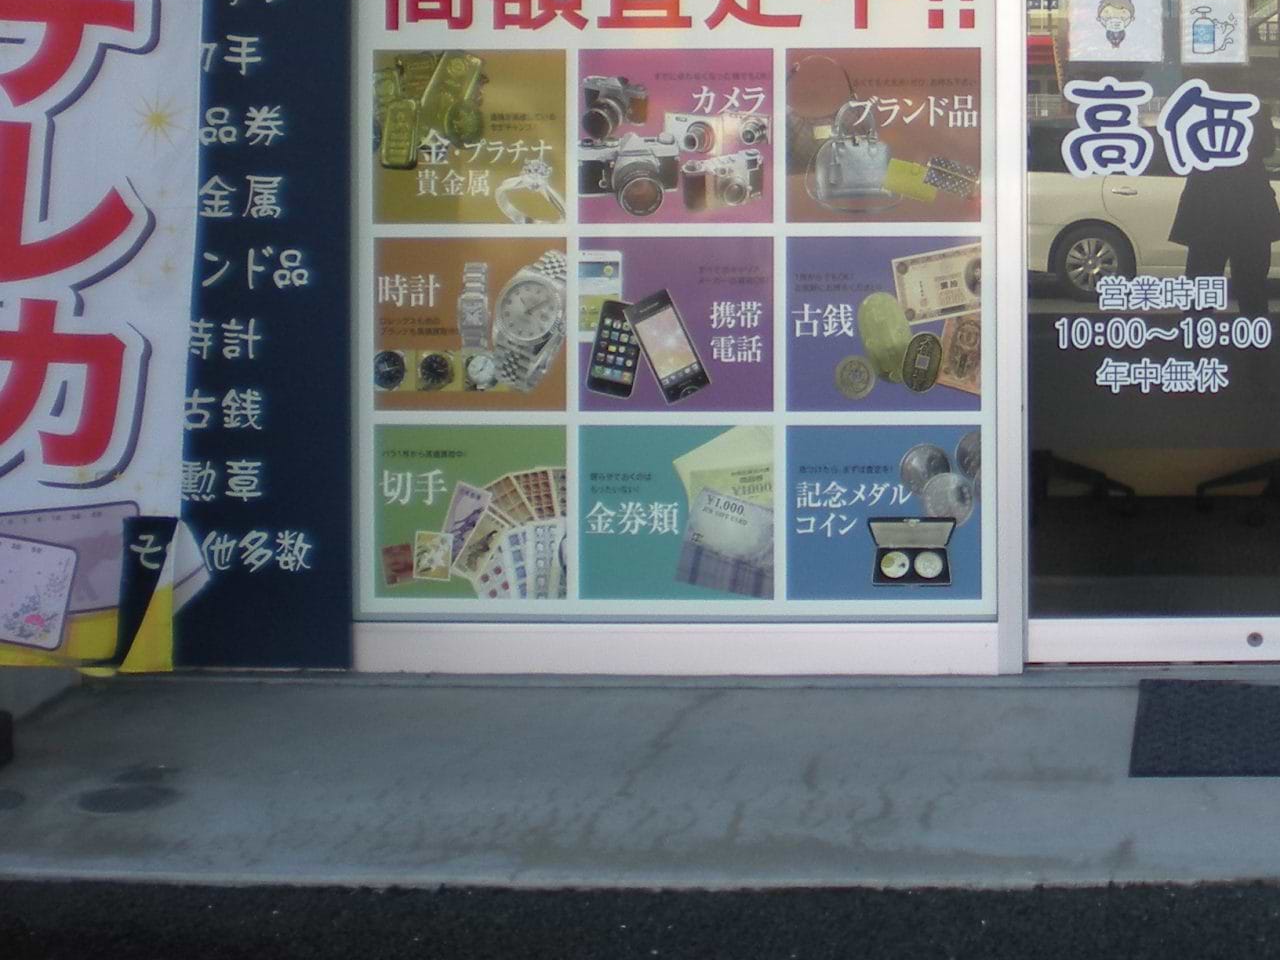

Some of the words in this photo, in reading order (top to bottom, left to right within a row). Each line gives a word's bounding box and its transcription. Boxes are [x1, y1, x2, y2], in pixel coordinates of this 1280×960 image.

[692, 85, 766, 115] カメラ
[848, 94, 978, 128] ブランド品
[1063, 78, 1259, 177] 高価
[416, 169, 491, 197] 貴金属
[378, 274, 441, 307] 時計
[1099, 277, 1227, 310] 営業時間
[710, 301, 763, 329] 携帯
[792, 303, 854, 337] 古銭
[710, 335, 763, 363] 電話
[1097, 359, 1228, 393] 年中無休
[379, 469, 447, 505] 切手
[796, 481, 912, 508] 記念メダル
[584, 501, 680, 535] 金券類
[796, 513, 857, 538] コイン
